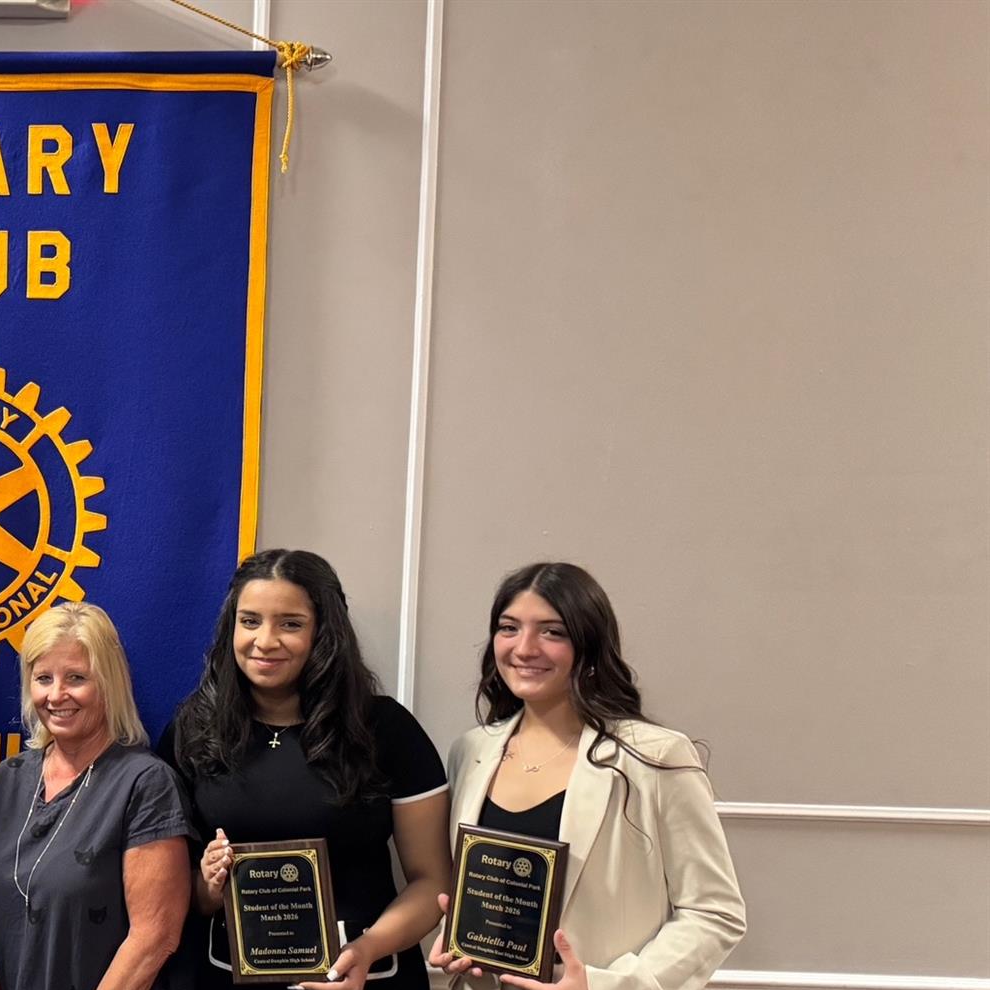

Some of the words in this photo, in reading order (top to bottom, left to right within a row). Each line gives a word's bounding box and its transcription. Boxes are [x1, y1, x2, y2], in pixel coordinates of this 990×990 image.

[481, 854, 512, 870] Rotary
[249, 869, 279, 879] Rotary
[467, 887, 494, 900] Student
[494, 893, 503, 901] of
[503, 894, 514, 903] the
[514, 897, 538, 909] Month
[243, 904, 270, 912] Student
[279, 903, 290, 911] the
[290, 902, 313, 910] Month
[481, 901, 504, 912] March
[260, 913, 283, 921] March
[283, 913, 299, 921] 2026
[466, 931, 505, 947] Gabriella
[506, 940, 527, 952] Paul
[250, 947, 286, 956] Madonna
[288, 946, 317, 955] Samuel
